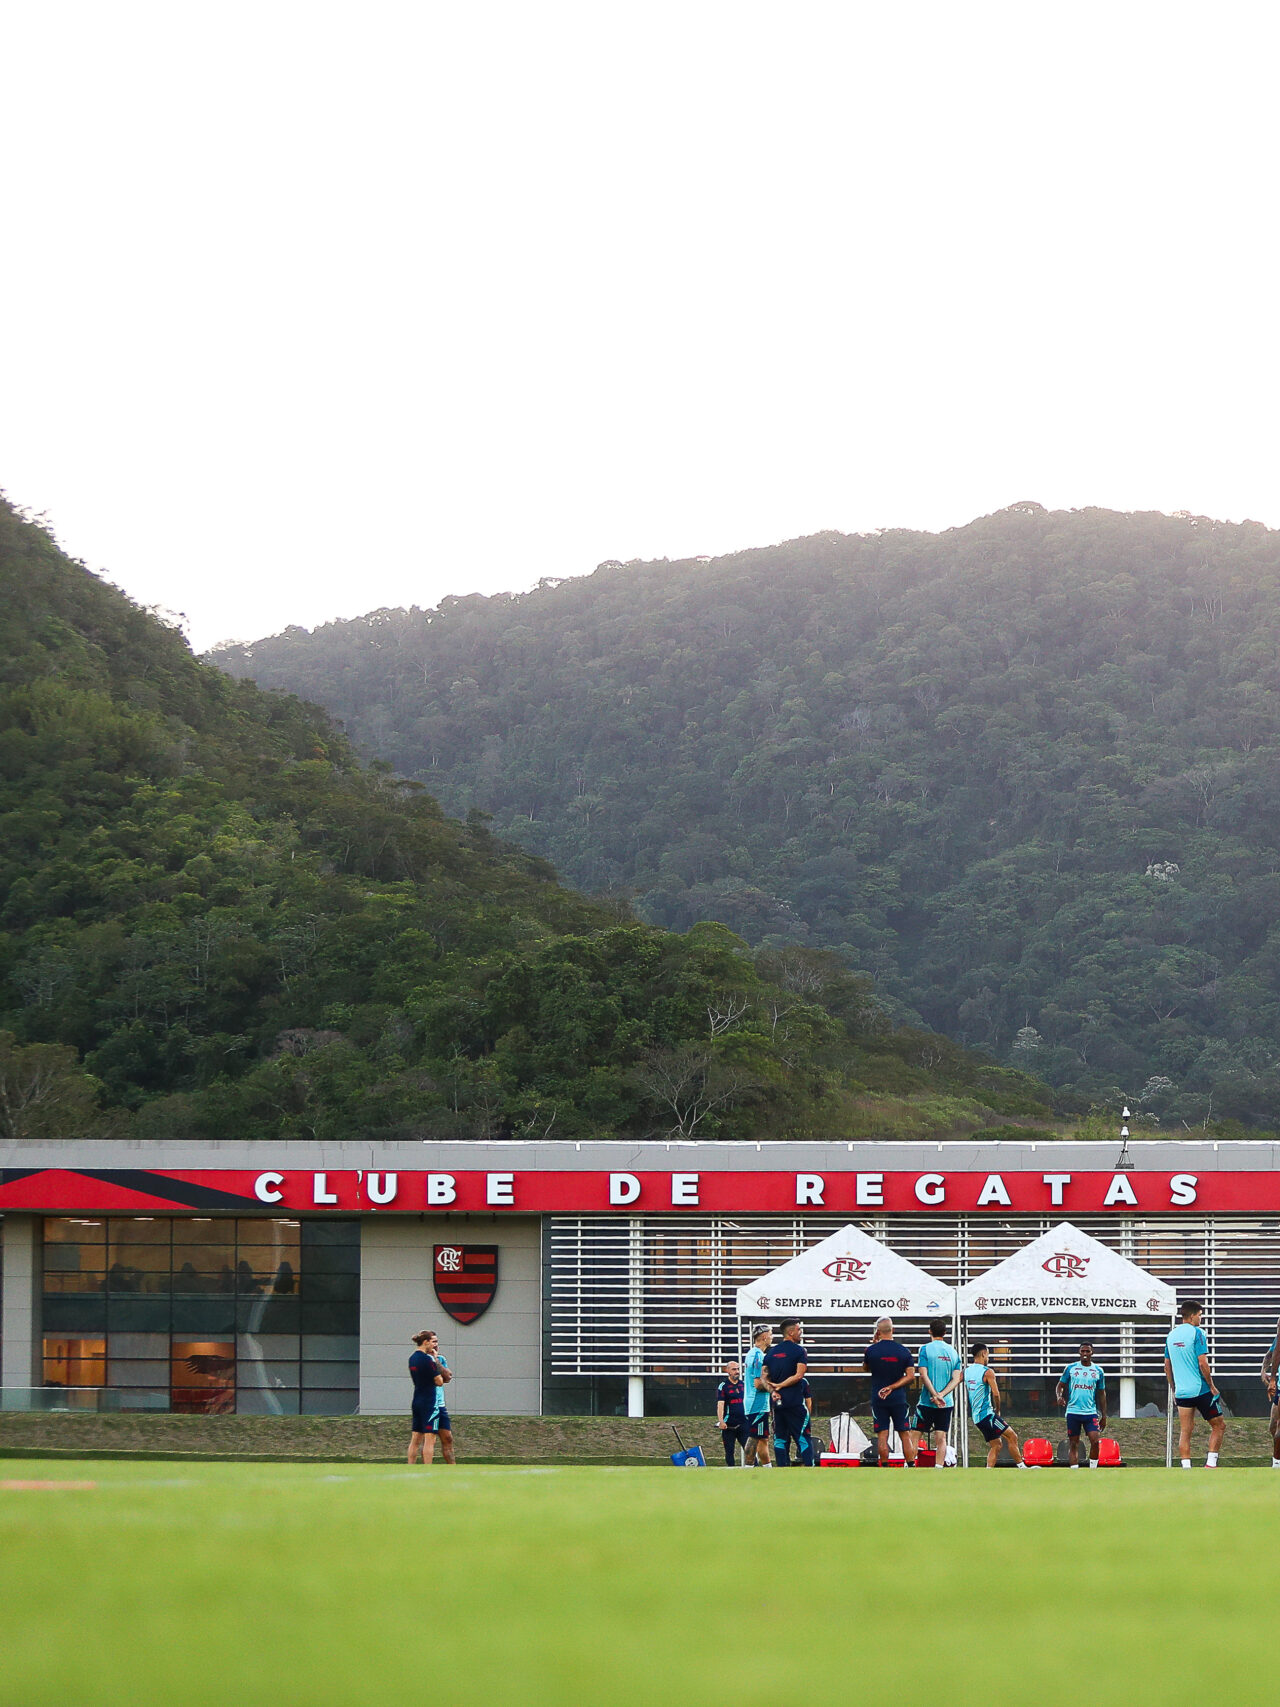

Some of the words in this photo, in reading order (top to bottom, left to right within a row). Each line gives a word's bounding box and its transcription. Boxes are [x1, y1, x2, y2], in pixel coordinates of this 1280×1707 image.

[254, 1172, 515, 1205] CLUBE
[608, 1172, 700, 1206] DE
[795, 1172, 1199, 1206] REGATAS
[774, 1297, 823, 1308] SEMPRE
[830, 1298, 895, 1309] FLAMENGO
[990, 1297, 1039, 1309] VENCER,
[1040, 1297, 1089, 1309] VENCER,
[1090, 1298, 1137, 1308] VENCER
